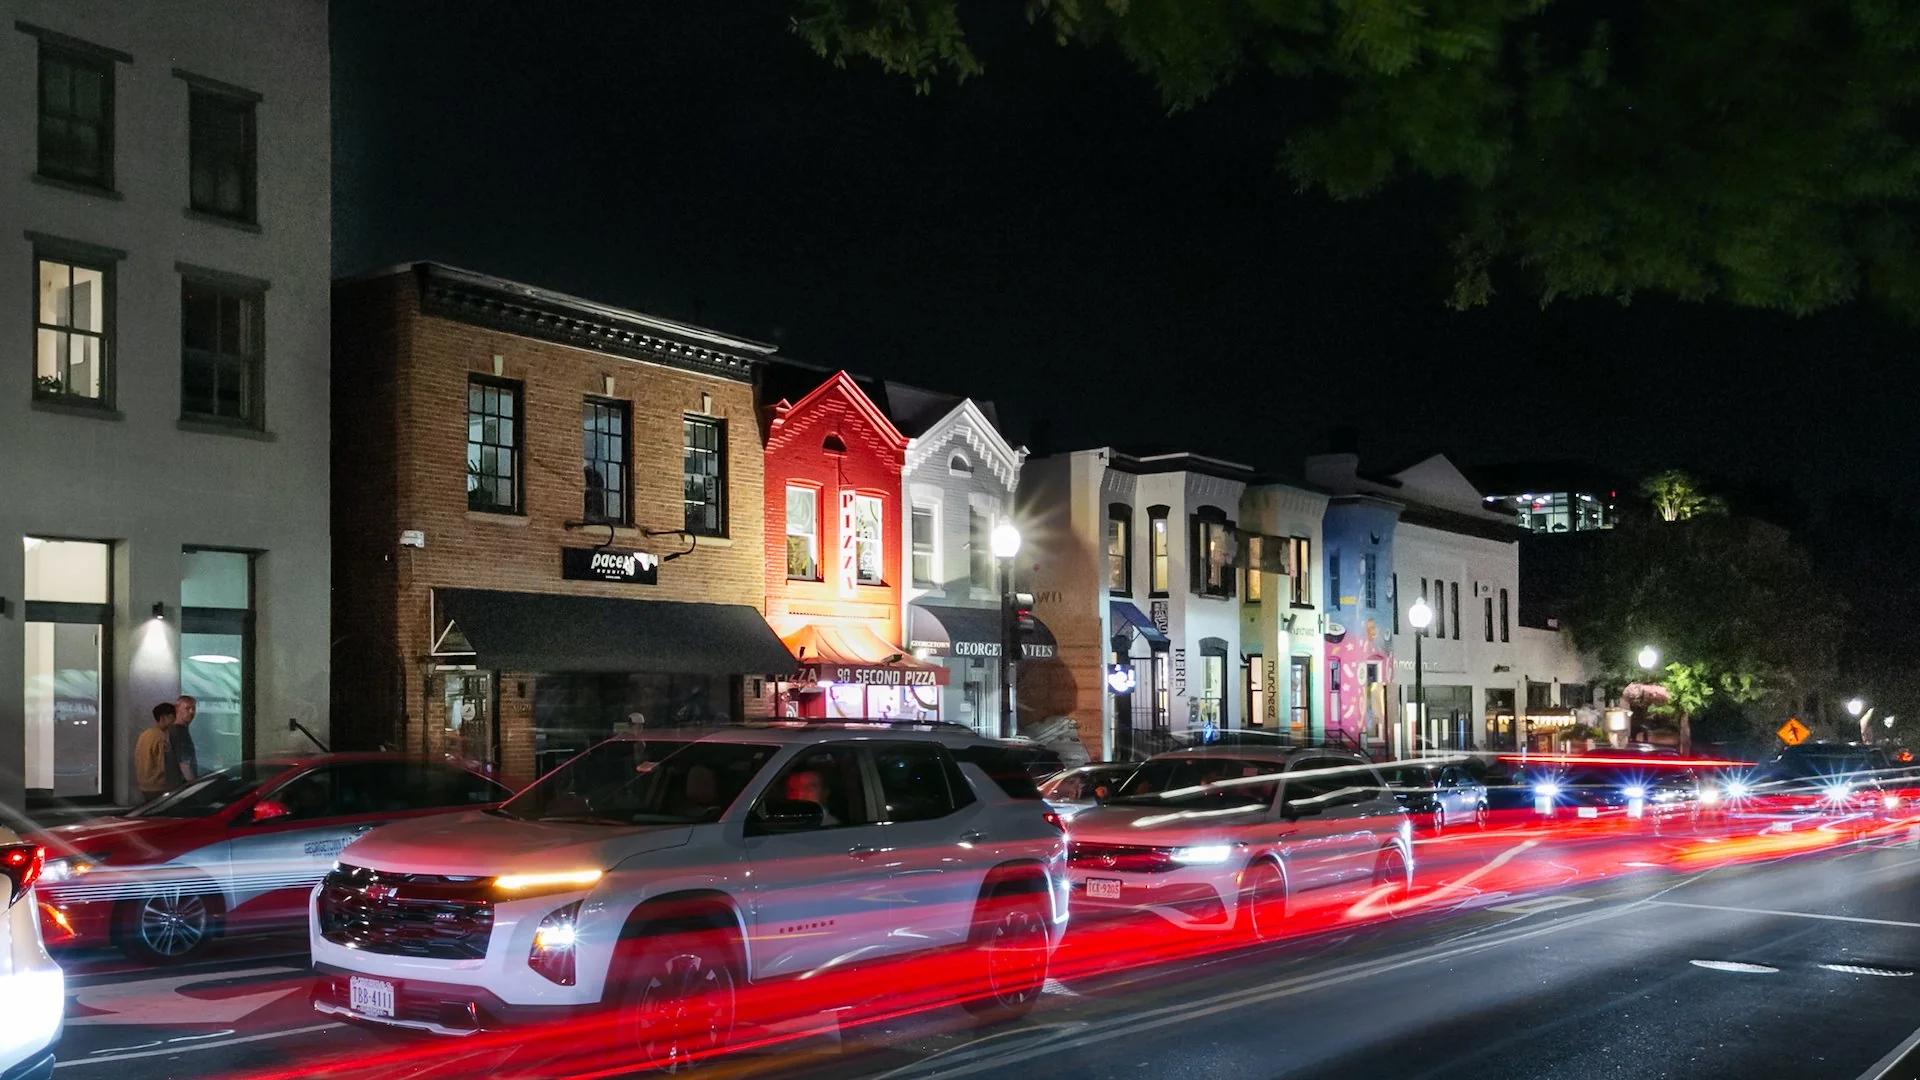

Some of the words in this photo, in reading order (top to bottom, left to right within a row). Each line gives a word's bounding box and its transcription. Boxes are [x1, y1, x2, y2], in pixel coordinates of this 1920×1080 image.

[842, 494, 854, 590] PIZZA
[1029, 644, 1053, 657] TEES
[837, 668, 850, 684] 90
[855, 669, 900, 685] SECOND
[904, 671, 937, 686] PIZZA
[1267, 660, 1276, 718] muncheez
[352, 986, 392, 1009] TBB-4111
